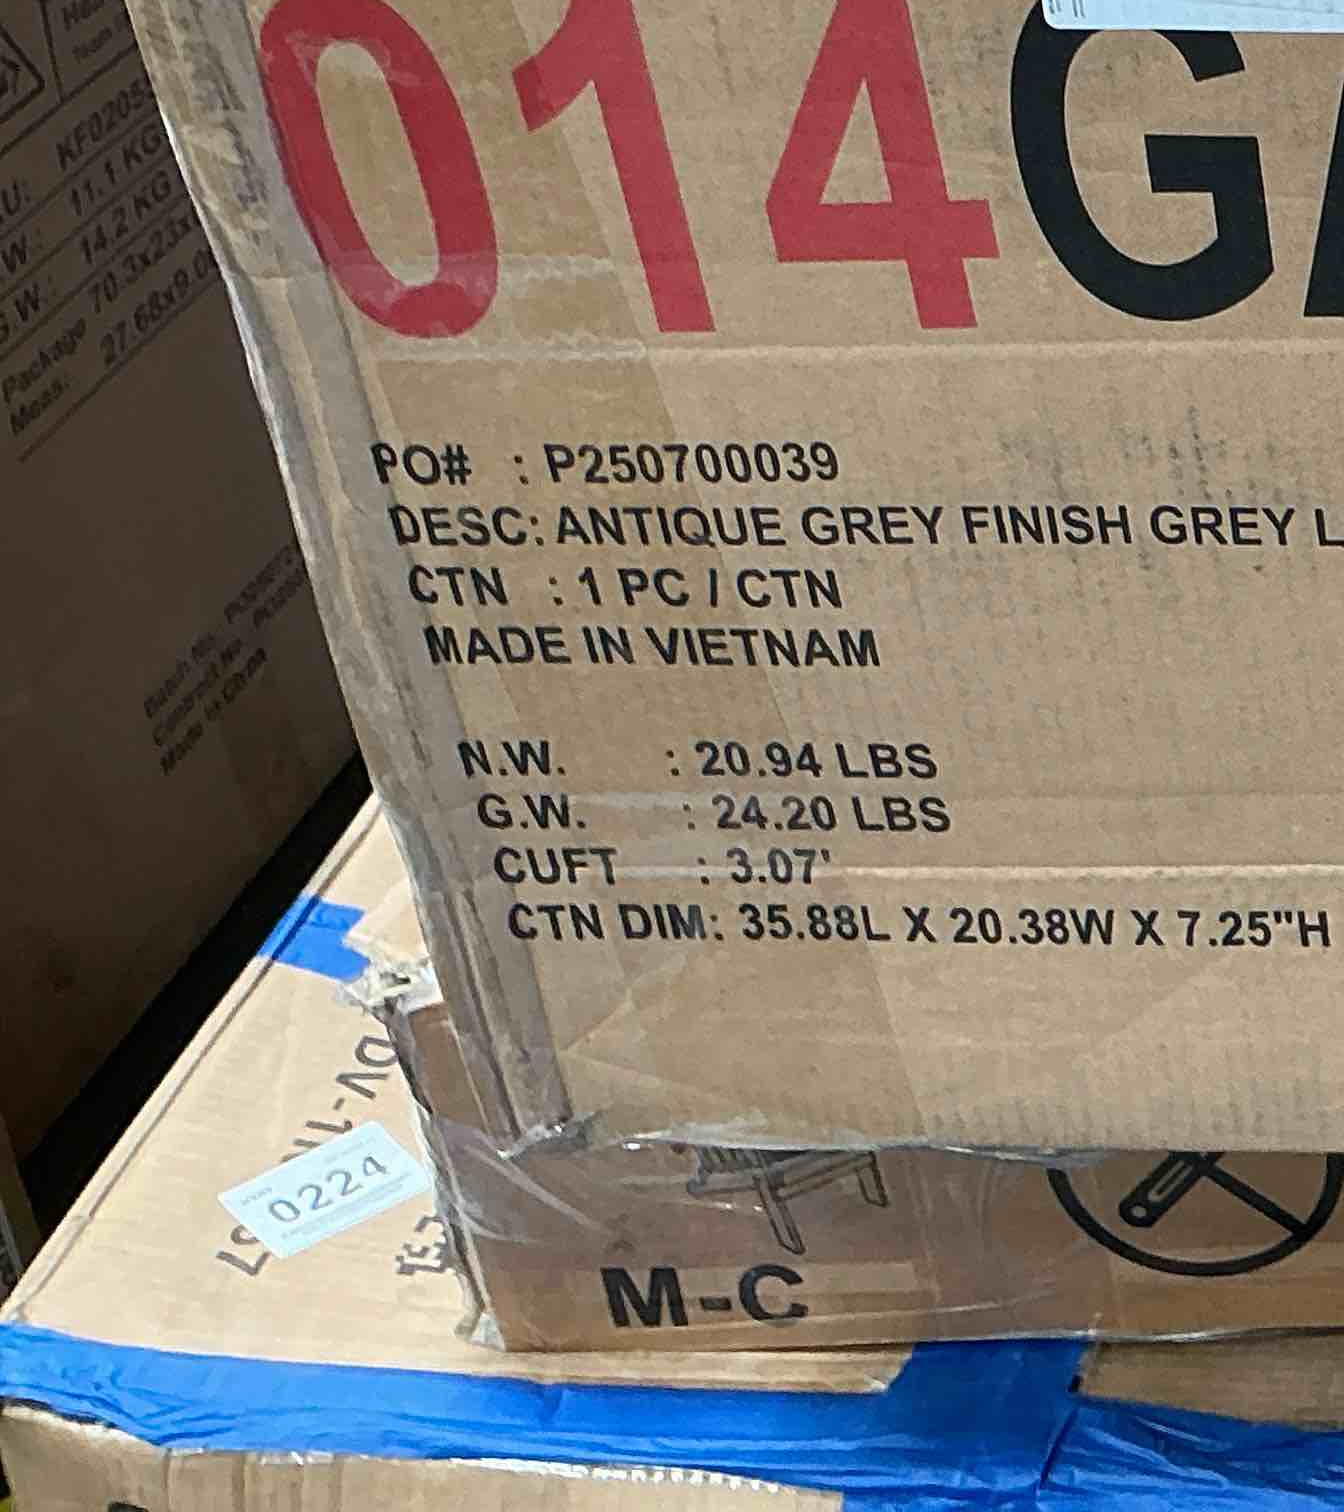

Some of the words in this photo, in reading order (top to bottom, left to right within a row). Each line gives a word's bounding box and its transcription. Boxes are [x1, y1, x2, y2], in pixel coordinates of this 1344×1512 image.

[121, 121, 162, 172] KG
[133, 168, 171, 211] KG
[370, 443, 472, 486] PO#
[544, 441, 838, 484] P250700039
[387, 501, 544, 546] DESC:
[556, 505, 787, 548] ANTIQUE
[801, 506, 943, 545] GREY
[961, 505, 1132, 544] FINISH
[1150, 505, 1296, 546] GREY
[408, 560, 508, 607] CTN
[617, 568, 690, 607] PC
[737, 569, 842, 608] CTN
[423, 620, 572, 666] MADE
[582, 626, 636, 664] IN
[644, 627, 880, 667] VIETNAM
[457, 739, 566, 779] N.W.
[694, 740, 822, 778] 20.94
[835, 742, 937, 779] LBS
[477, 793, 586, 830] G.W.
[712, 794, 837, 831] 24.20
[851, 796, 950, 833] LBS
[494, 846, 617, 887] CUFT
[726, 848, 831, 885] 3.07'
[508, 902, 604, 942] CTN
[618, 904, 724, 942] DIM:
[739, 903, 891, 941] 35.88L
[902, 906, 938, 944] X
[949, 907, 1114, 945] 20.38W
[1130, 910, 1165, 946] X
[1176, 910, 1331, 948] 7.25"H
[266, 1154, 388, 1226] 0224
[603, 1263, 807, 1330] M-C
